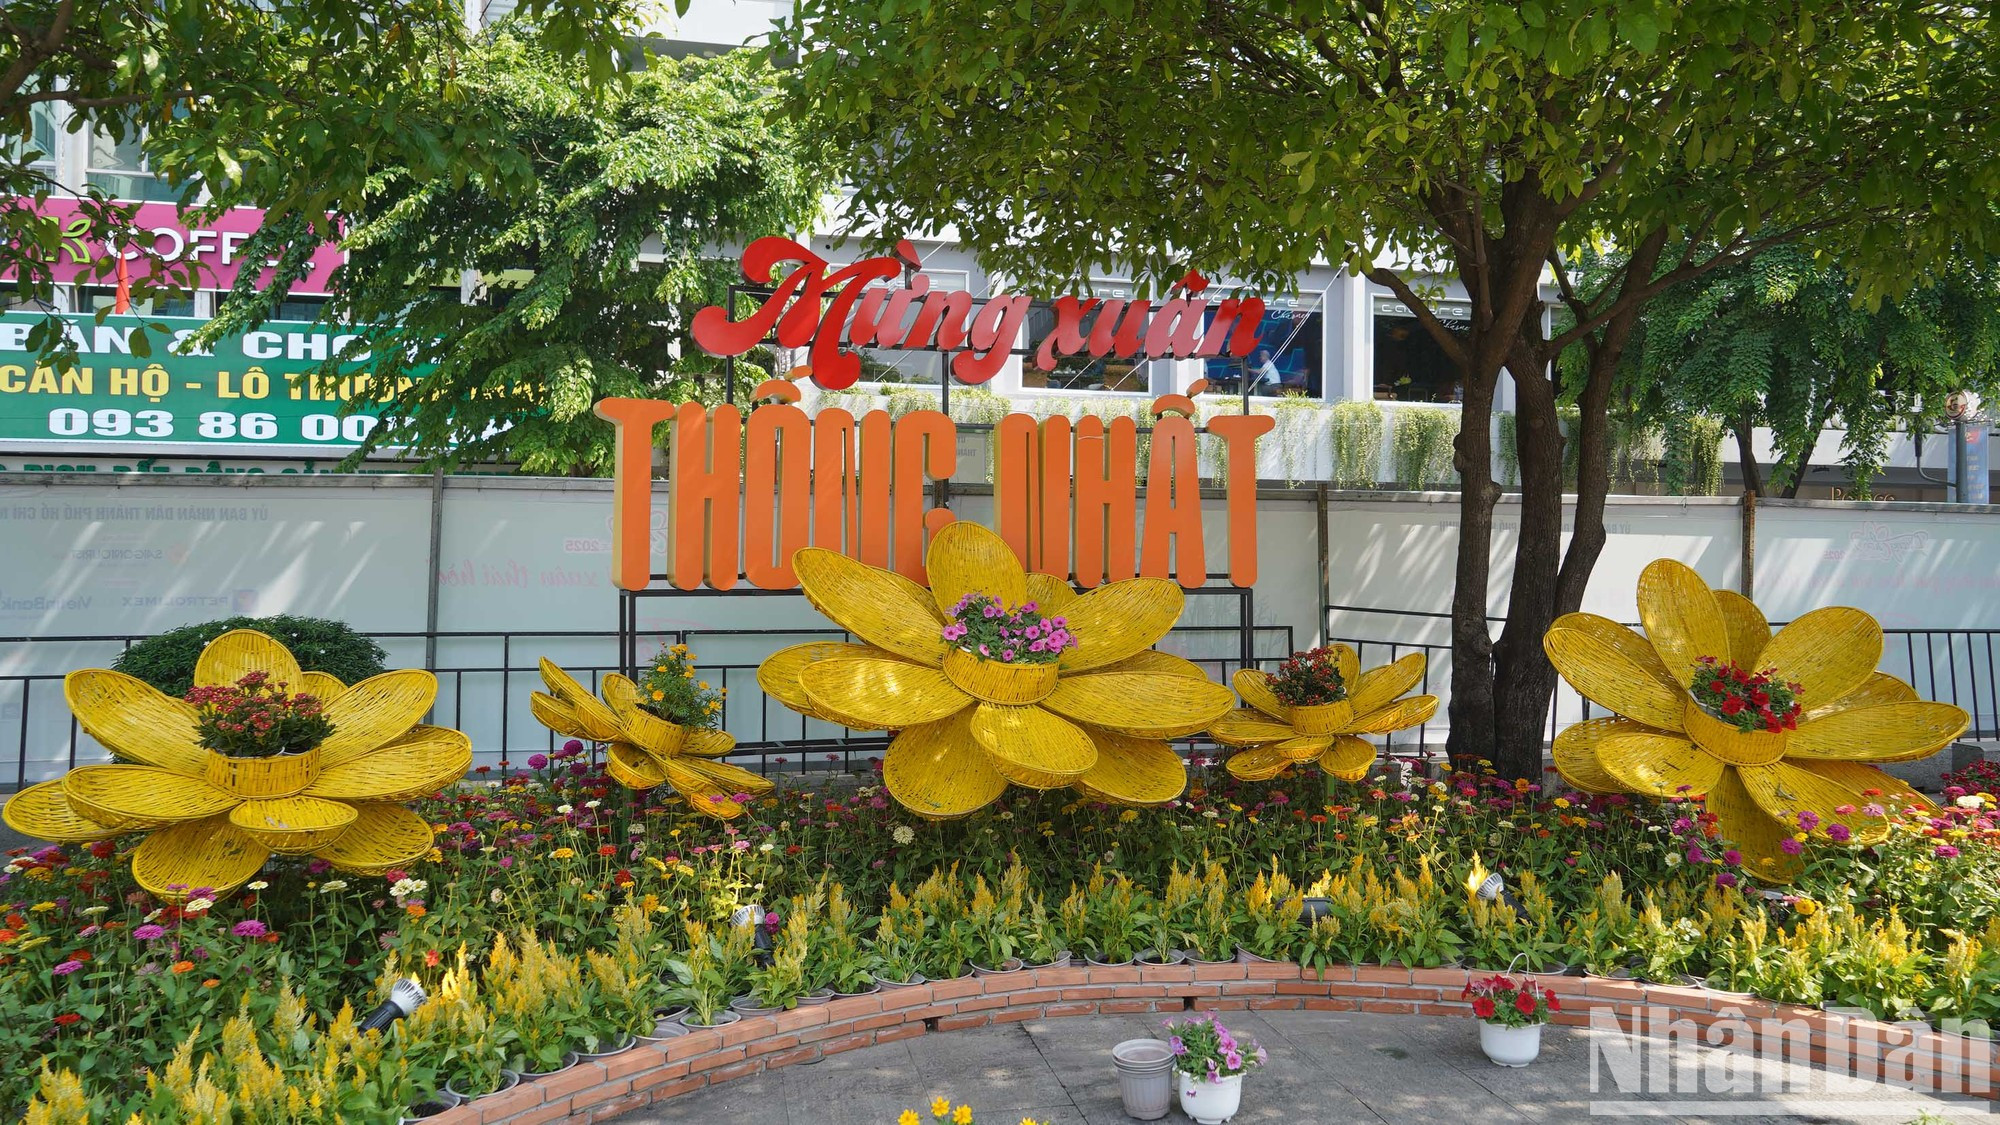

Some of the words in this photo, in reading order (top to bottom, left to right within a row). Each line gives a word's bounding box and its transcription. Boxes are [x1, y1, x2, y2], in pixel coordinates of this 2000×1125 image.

[691, 237, 1031, 390] Mừng
[1034, 268, 1264, 371] xuân
[0, 319, 132, 354] BÁN
[110, 363, 170, 402] HỘ
[218, 366, 270, 400] LÔ
[49, 407, 174, 438] 093
[198, 411, 278, 440] 86
[594, 366, 957, 592] THỐNG
[994, 378, 1275, 588] NHẤT
